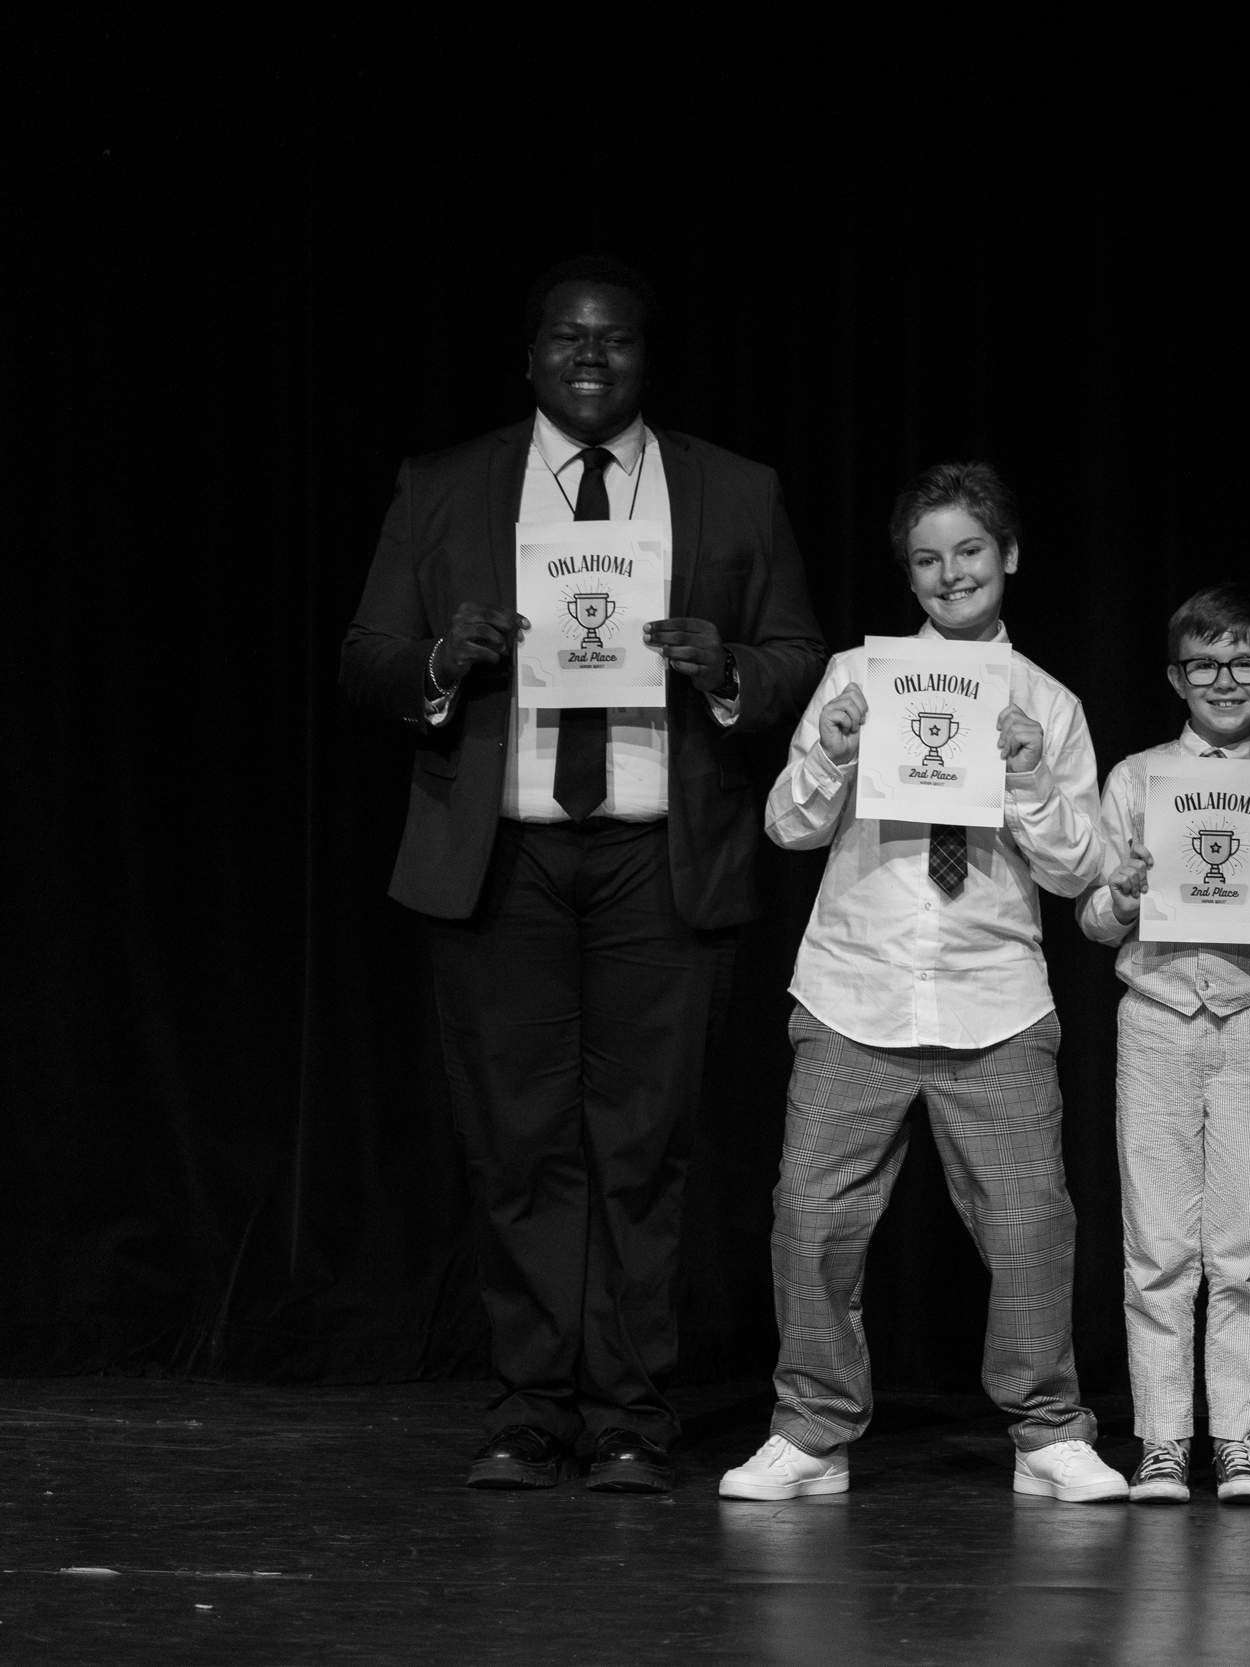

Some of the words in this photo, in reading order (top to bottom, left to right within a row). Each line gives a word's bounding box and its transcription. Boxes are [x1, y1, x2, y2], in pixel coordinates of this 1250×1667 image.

[548, 555, 633, 578] OKLAHOMA
[568, 652, 588, 663] 2nd
[590, 652, 617, 662] Place
[894, 674, 980, 700] OKLAHOMA
[908, 768, 928, 779] 2nd
[930, 769, 958, 781] Place
[1190, 886, 1210, 897] 2nd
[1212, 887, 1239, 898] Place
